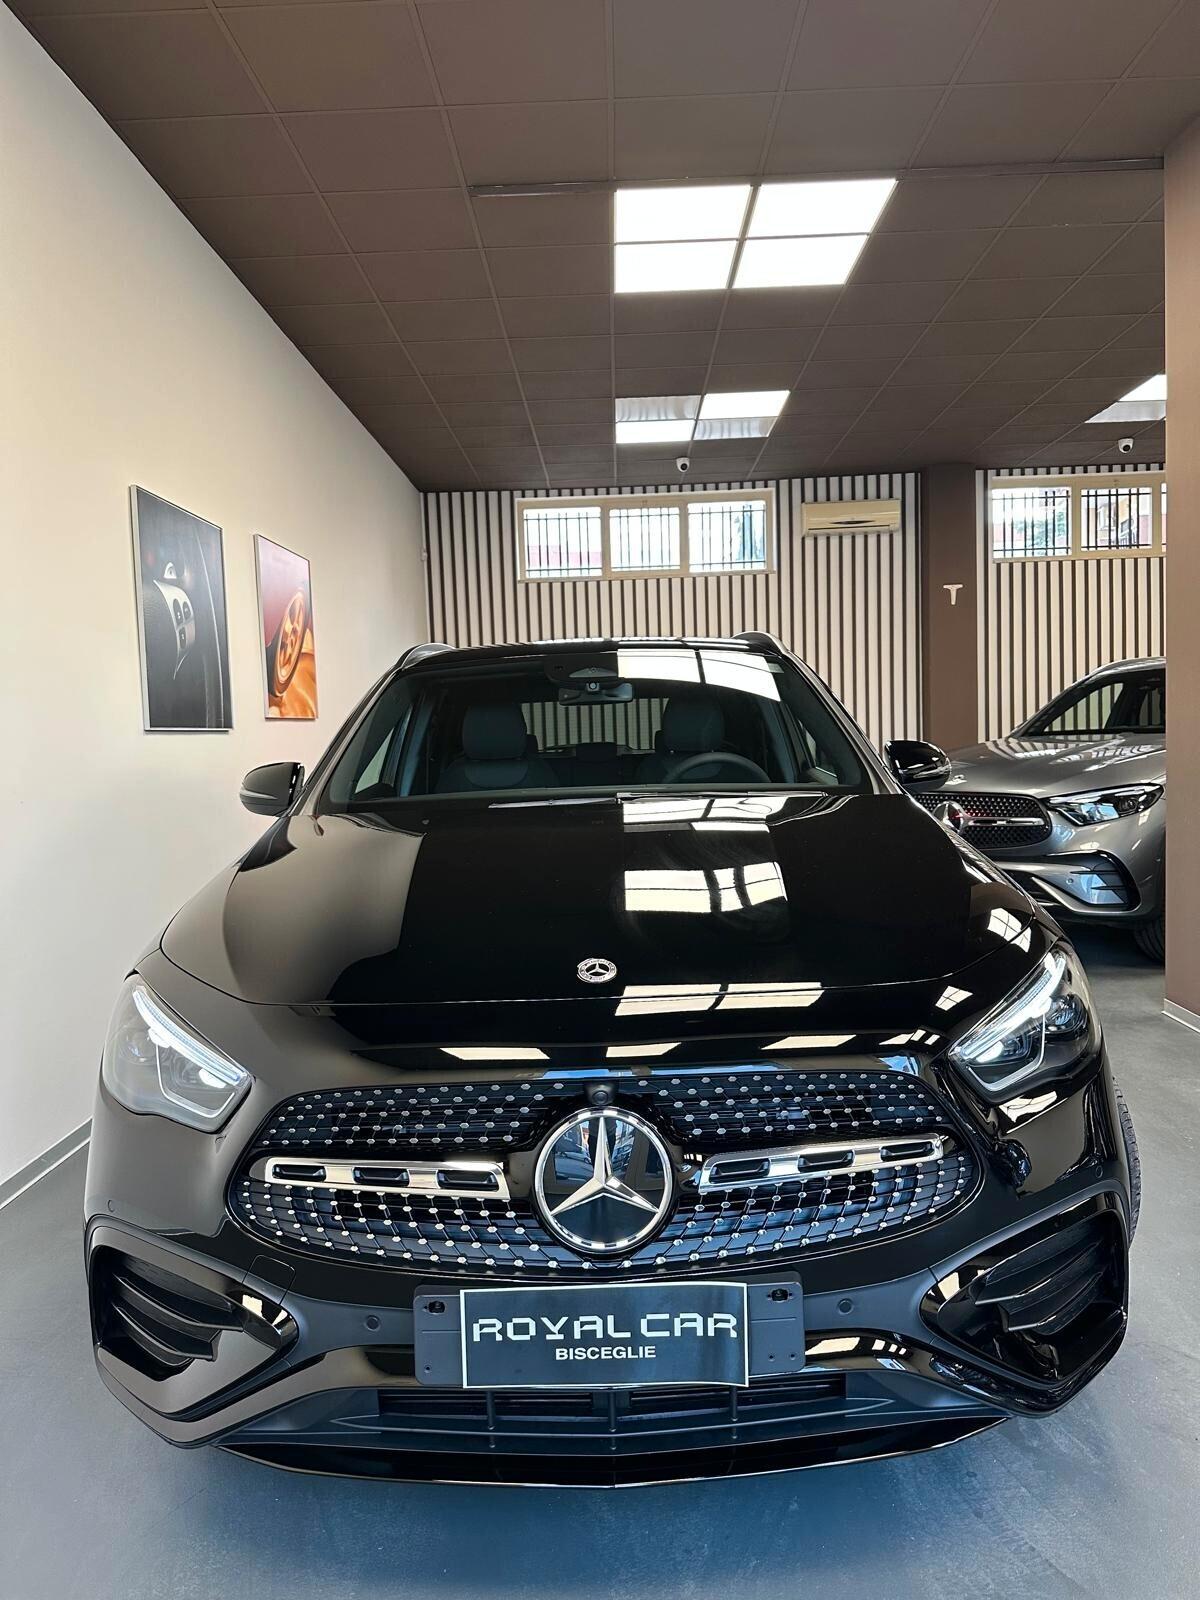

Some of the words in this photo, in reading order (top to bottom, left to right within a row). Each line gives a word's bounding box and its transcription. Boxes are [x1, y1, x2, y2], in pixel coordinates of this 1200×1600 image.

[472, 1314, 632, 1342] ROYAL
[640, 1312, 738, 1338] CAR
[555, 1345, 656, 1360] BISCEGLIE
